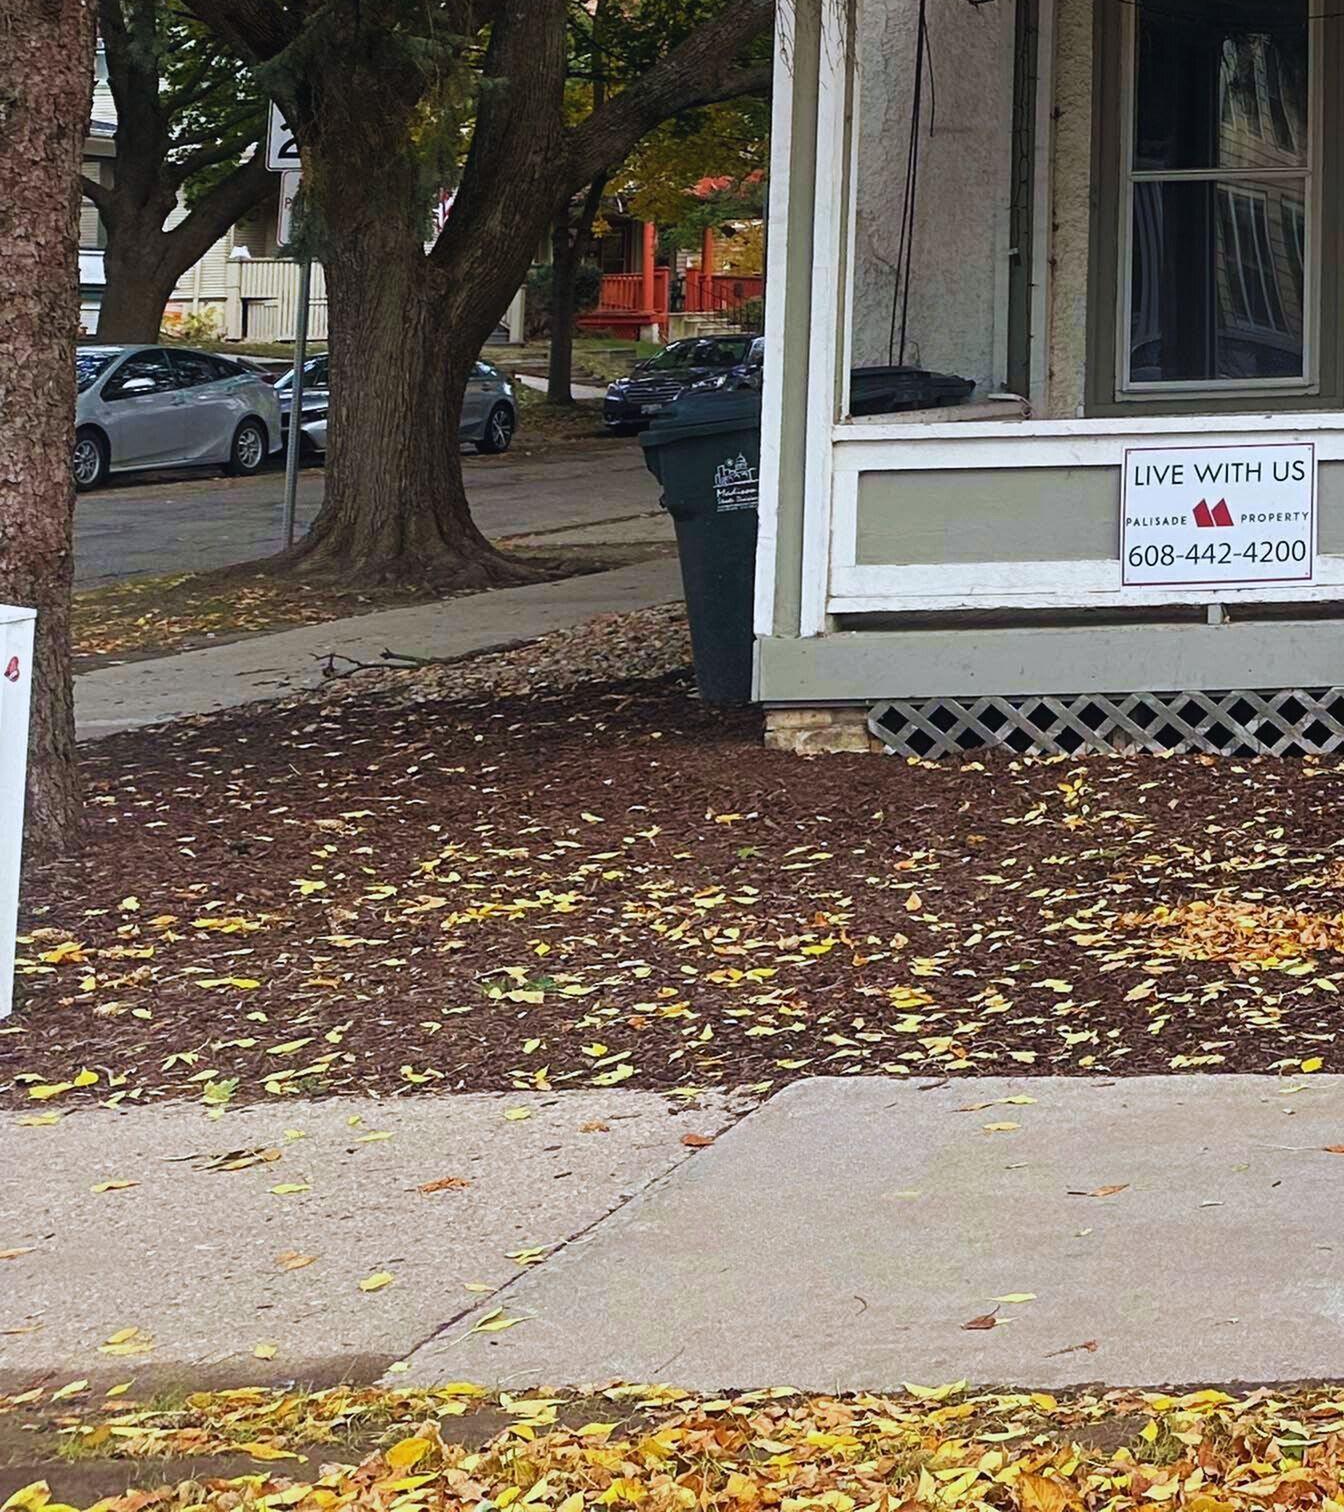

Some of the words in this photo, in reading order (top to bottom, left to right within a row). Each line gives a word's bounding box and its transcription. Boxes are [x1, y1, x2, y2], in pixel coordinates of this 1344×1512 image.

[1135, 465, 1184, 486] LIVE
[1194, 462, 1262, 483] WITH
[1273, 460, 1305, 482] US
[1126, 516, 1188, 527] PALISADE
[1240, 511, 1309, 523] PROPERTY
[1128, 540, 1307, 567] 608-442-4200
